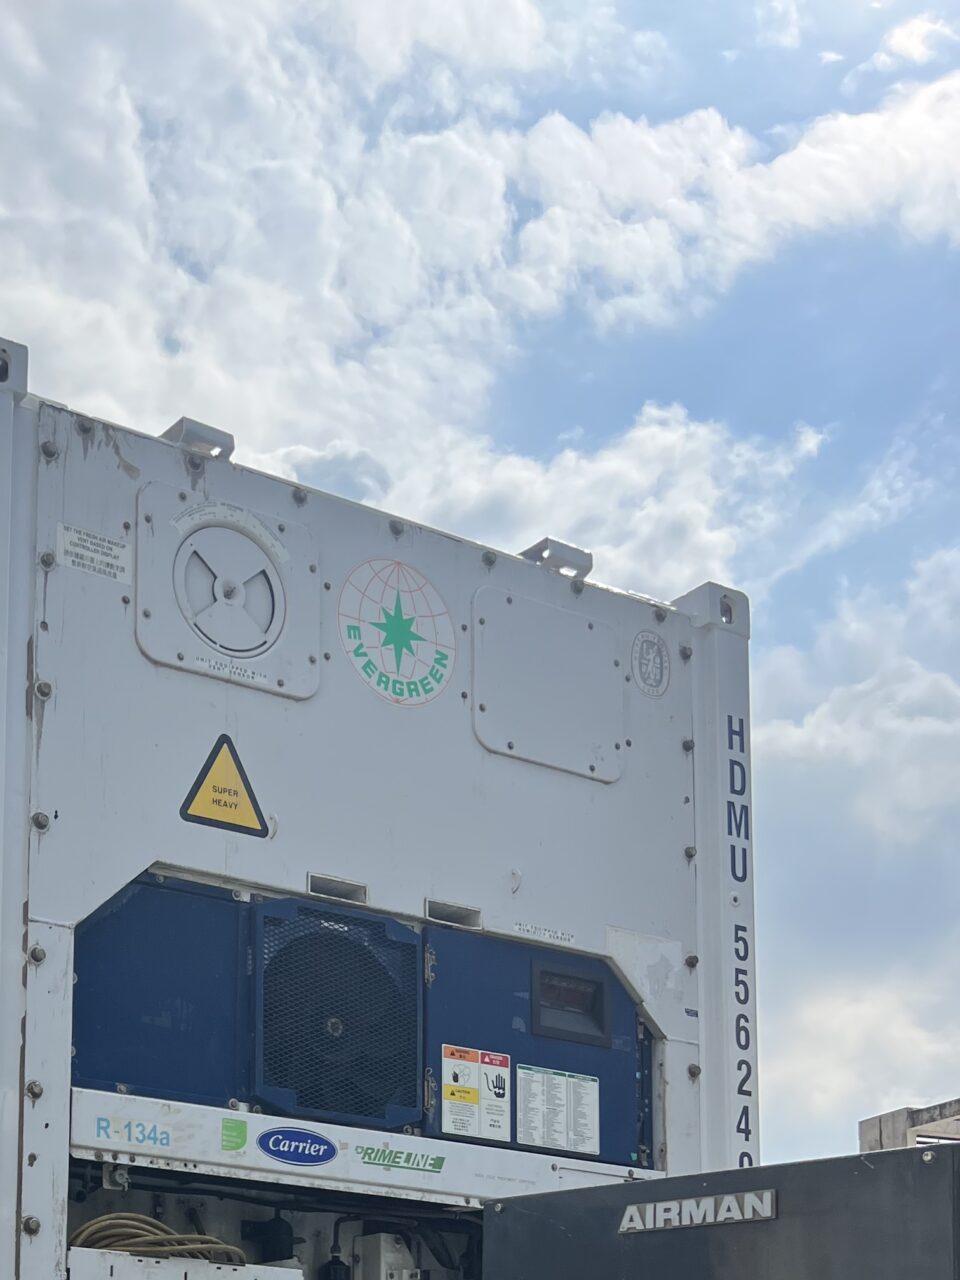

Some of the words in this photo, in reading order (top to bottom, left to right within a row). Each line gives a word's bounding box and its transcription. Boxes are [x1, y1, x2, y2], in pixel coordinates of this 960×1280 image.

[346, 624, 449, 698] EVERGREEN
[212, 784, 239, 798] SUPER
[212, 797, 238, 810] HEAVY
[727, 714, 750, 884] HDMU
[268, 1134, 328, 1157] Carrier
[619, 1191, 772, 1232] AIRMAN
